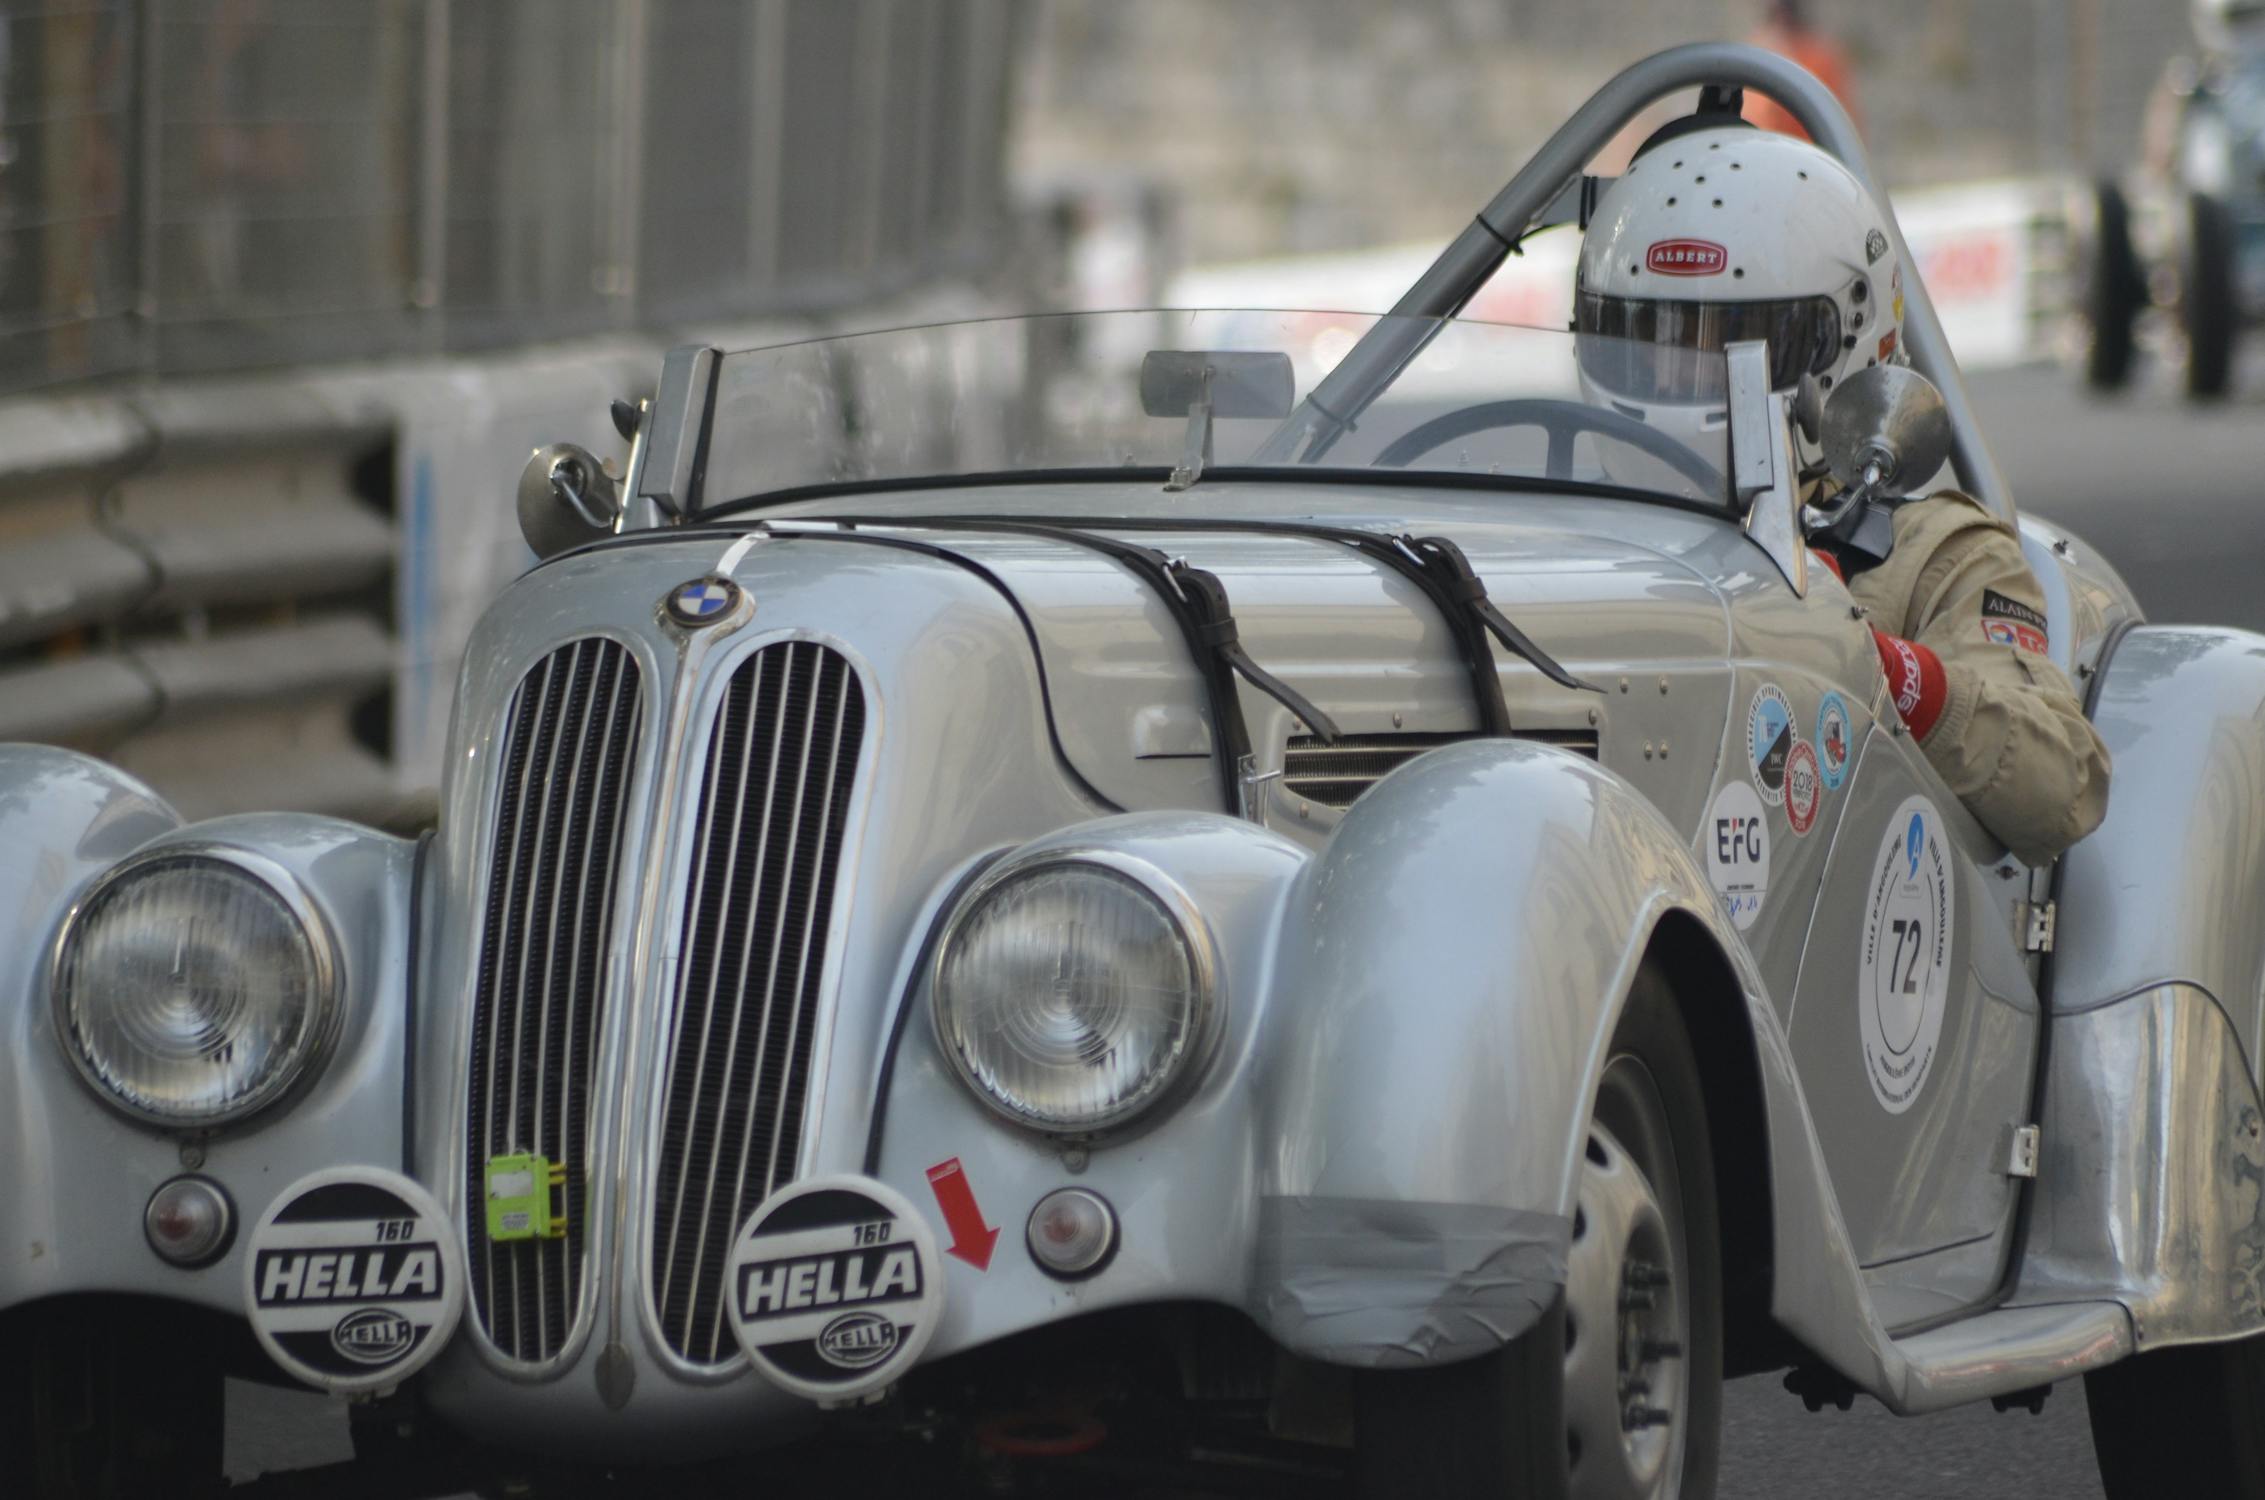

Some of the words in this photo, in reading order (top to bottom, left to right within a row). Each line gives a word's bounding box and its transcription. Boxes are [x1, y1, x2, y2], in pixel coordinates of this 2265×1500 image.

[1654, 250, 1719, 265] ALBERT
[1792, 770, 1813, 792] 2018
[1716, 816, 1761, 865] EFG
[1890, 919, 1922, 994] 72
[375, 1220, 415, 1242] 160
[853, 1221, 892, 1246] 160
[259, 1250, 437, 1301] HELLA
[744, 1249, 917, 1315] HELLA
[338, 1320, 412, 1346] HELLA
[823, 1321, 896, 1348] HELLA
